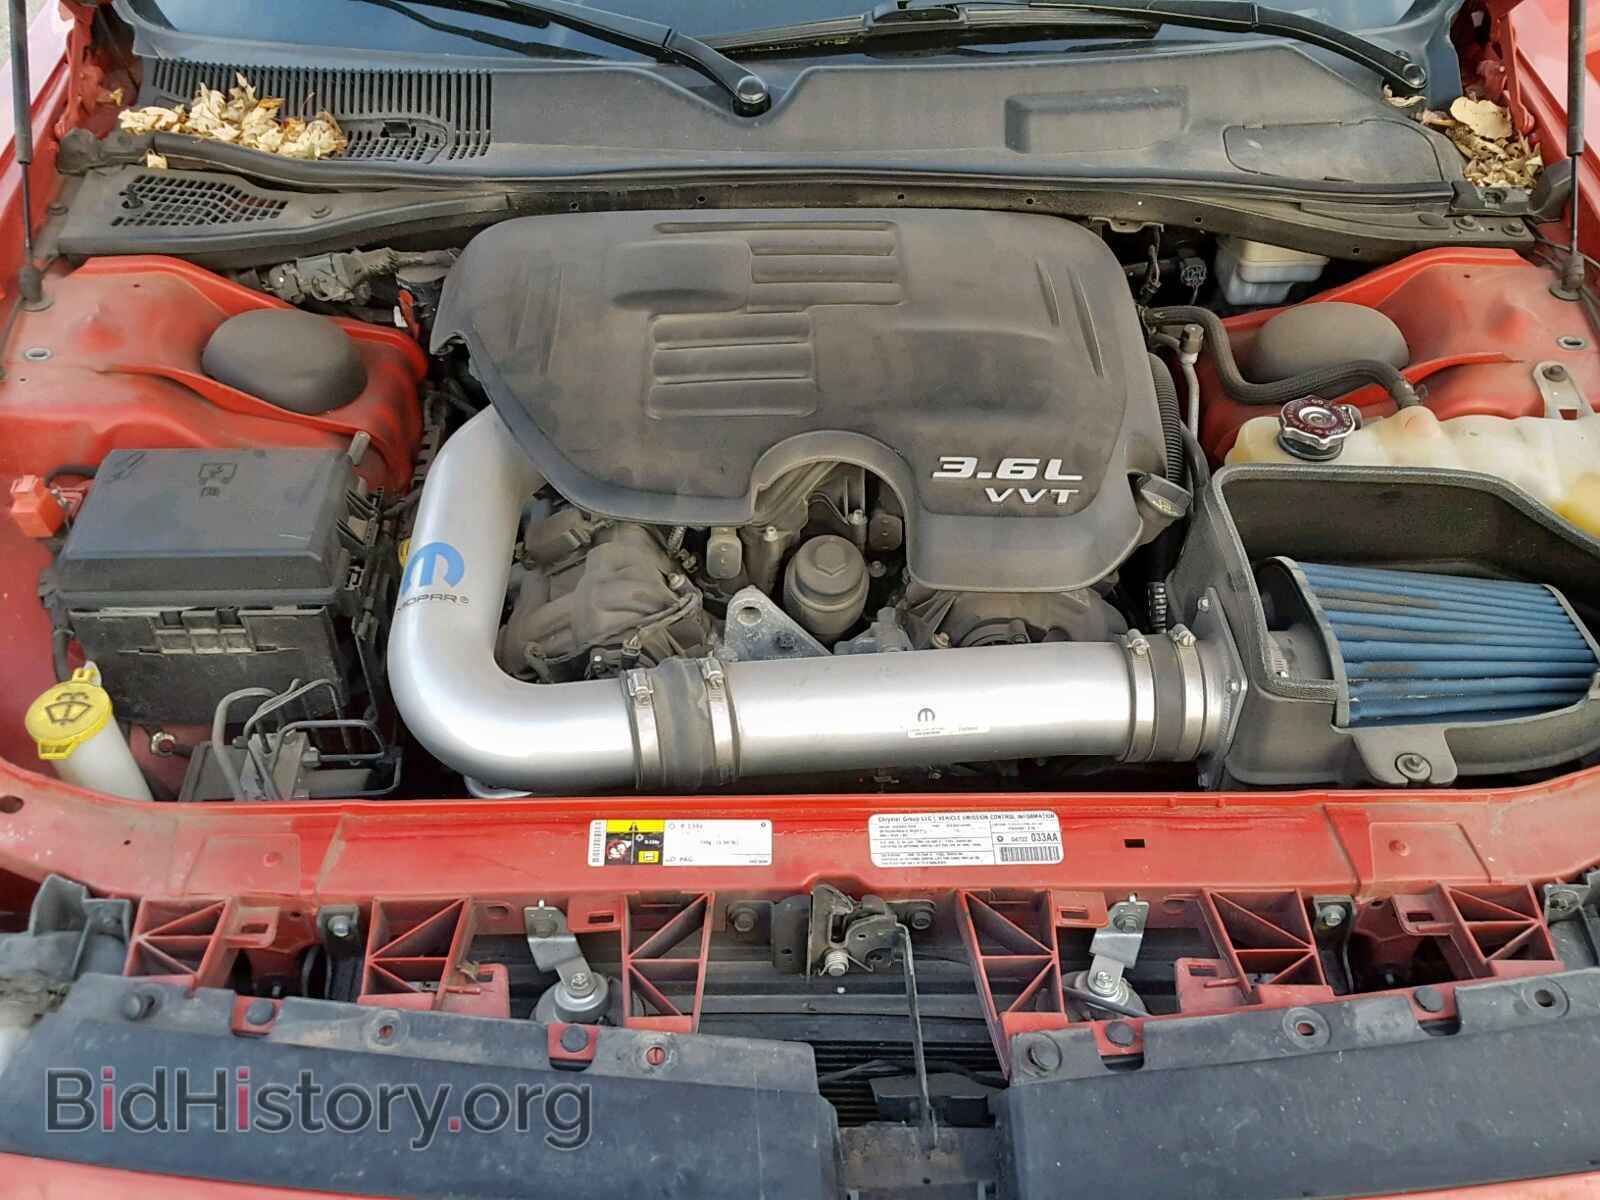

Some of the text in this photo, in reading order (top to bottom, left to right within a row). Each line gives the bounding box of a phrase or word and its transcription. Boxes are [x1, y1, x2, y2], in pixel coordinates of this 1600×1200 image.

[931, 456, 1083, 480] 3.6L
[985, 487, 1079, 505] VVT
[903, 815, 920, 823] Group
[1030, 831, 1059, 842] 033AA
